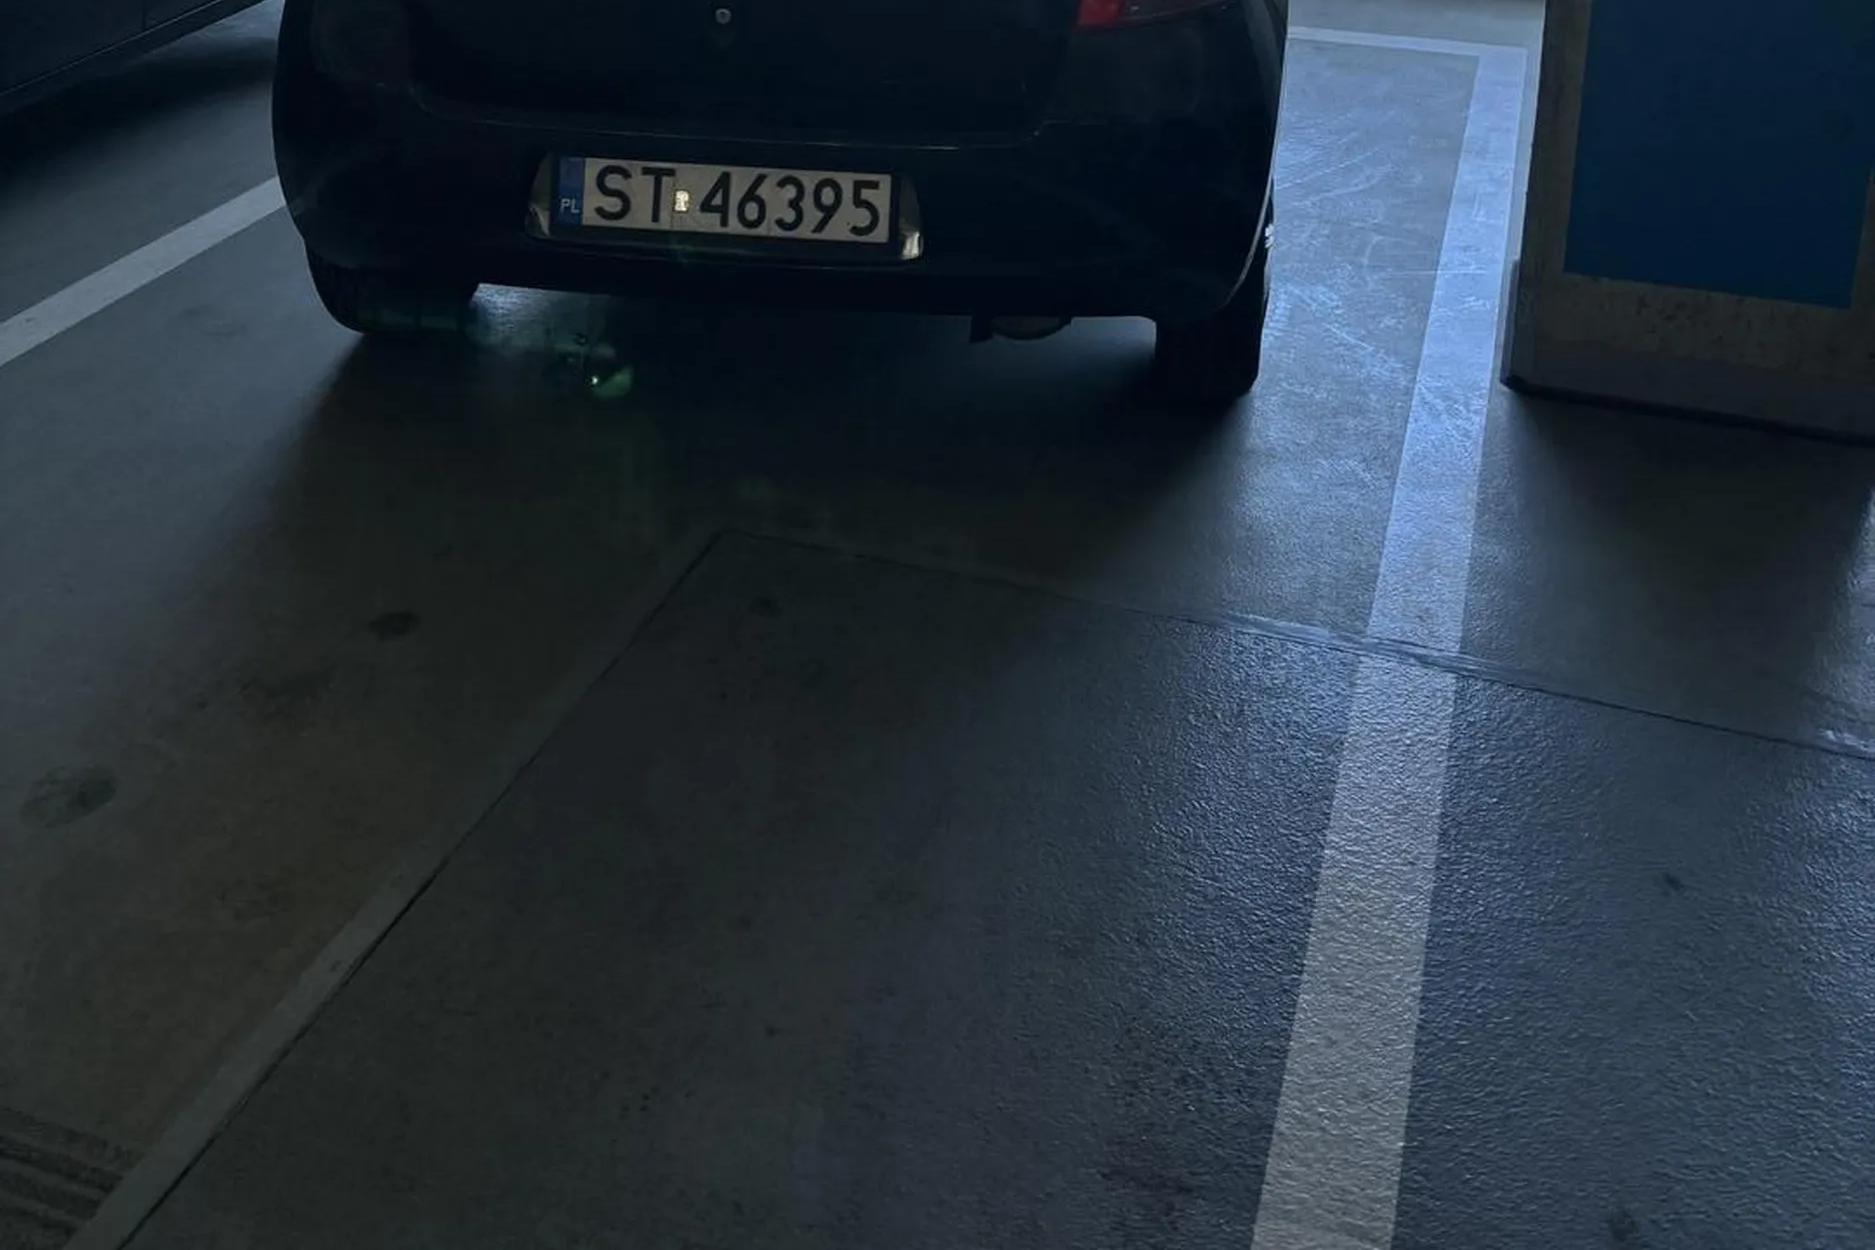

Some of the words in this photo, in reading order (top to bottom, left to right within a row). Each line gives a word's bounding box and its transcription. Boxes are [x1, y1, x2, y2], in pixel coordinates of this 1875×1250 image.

[559, 197, 581, 214] PL
[594, 165, 676, 223] ST
[699, 171, 881, 237] 46395
